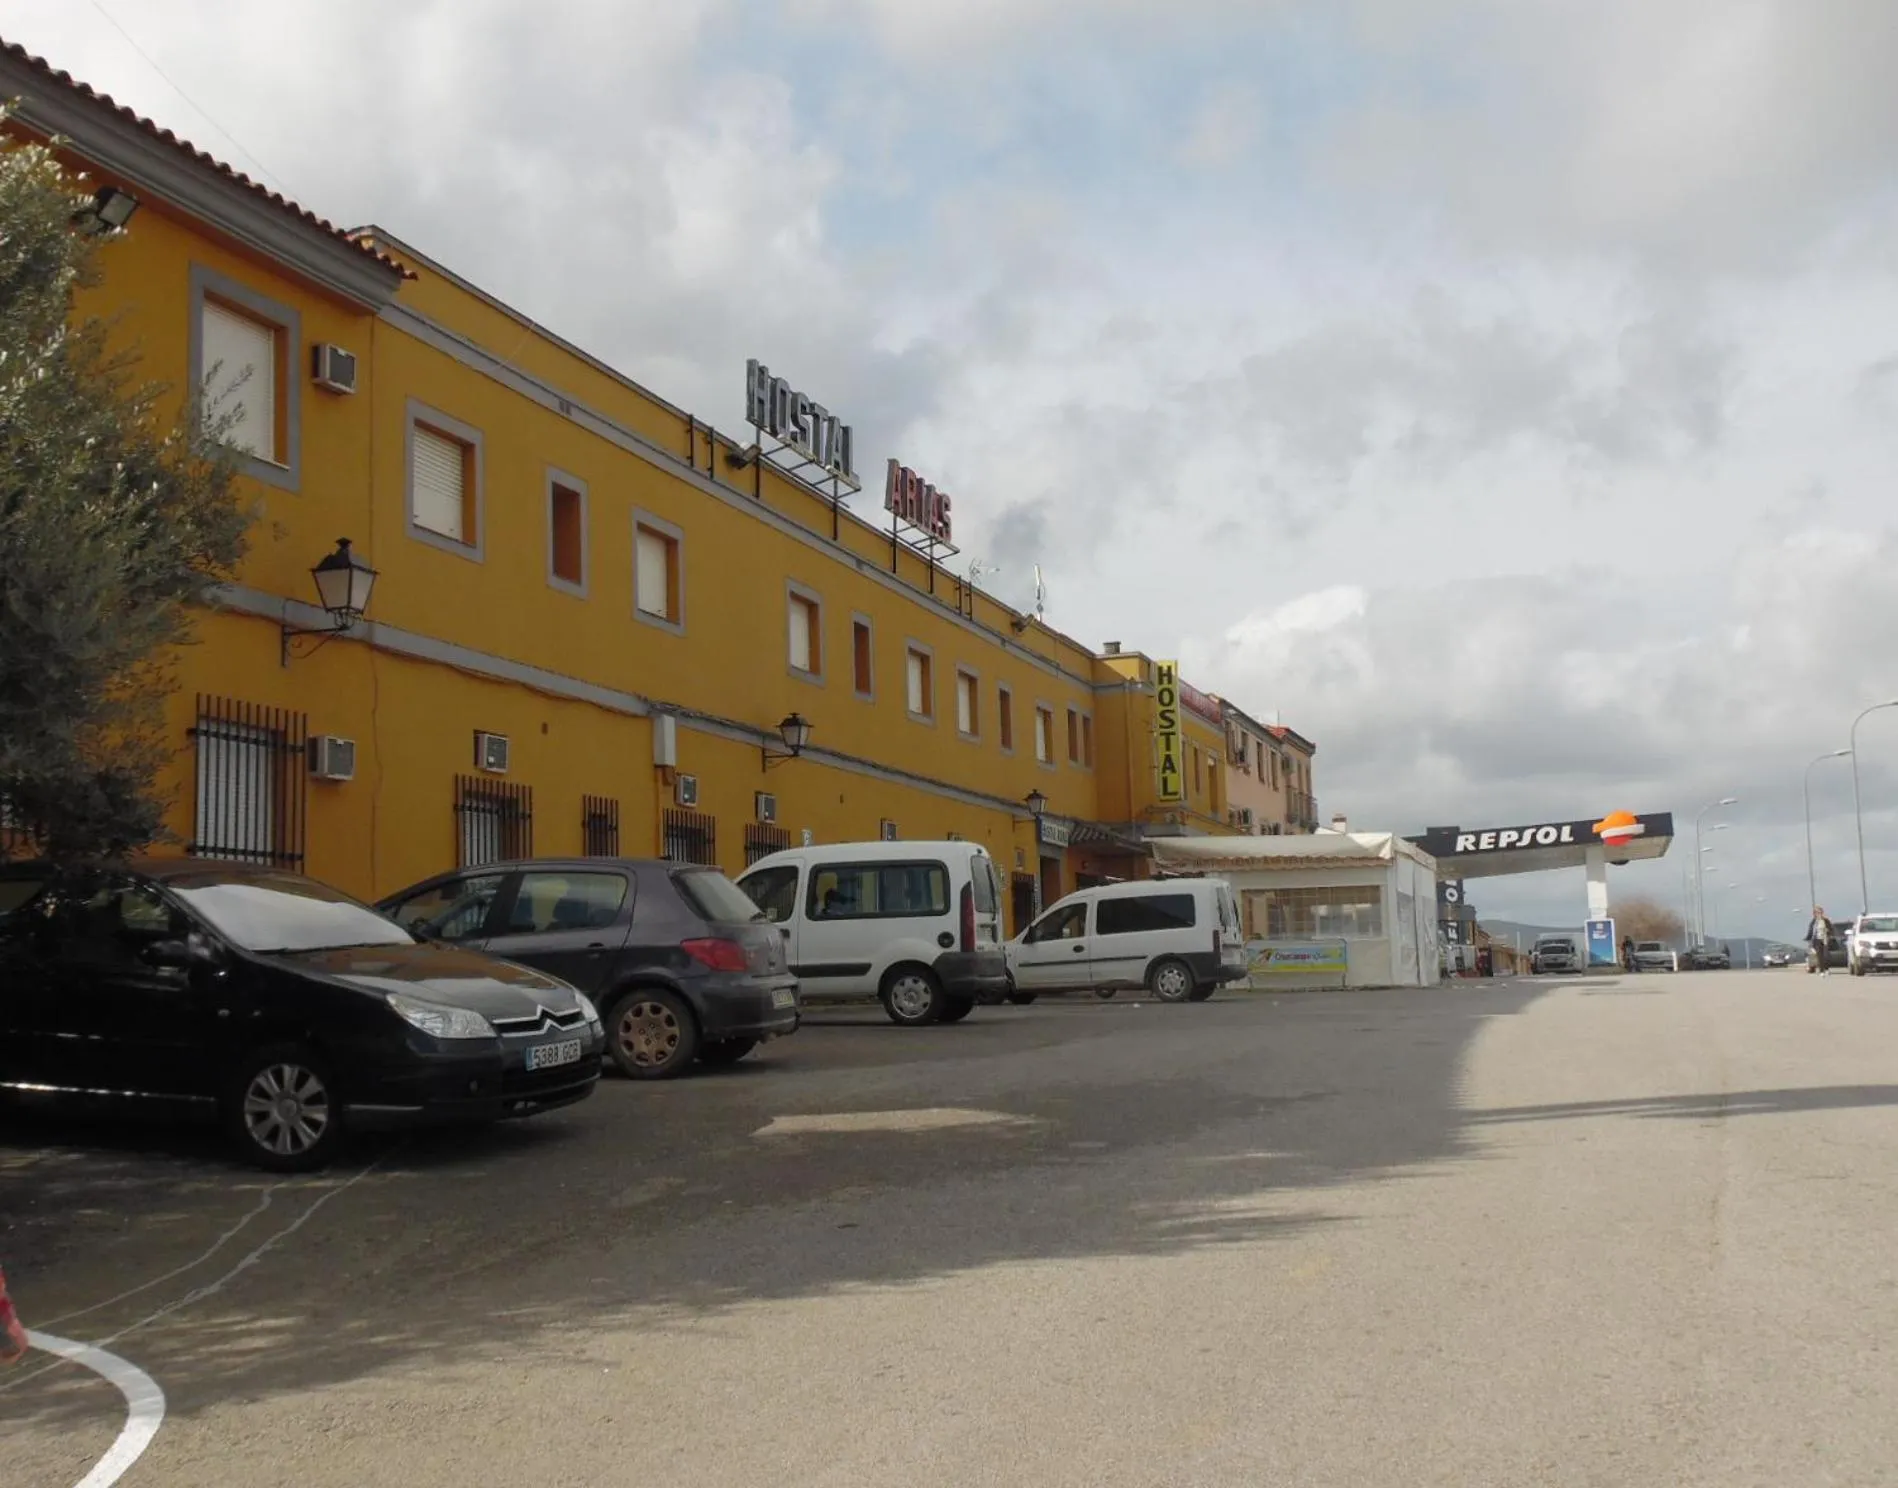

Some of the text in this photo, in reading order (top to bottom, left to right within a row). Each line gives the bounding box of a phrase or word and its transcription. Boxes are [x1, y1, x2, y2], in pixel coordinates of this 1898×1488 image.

[745, 358, 860, 487] HOSTAL
[1157, 664, 1179, 796] HOSTAL
[1455, 825, 1574, 852] REPSOL
